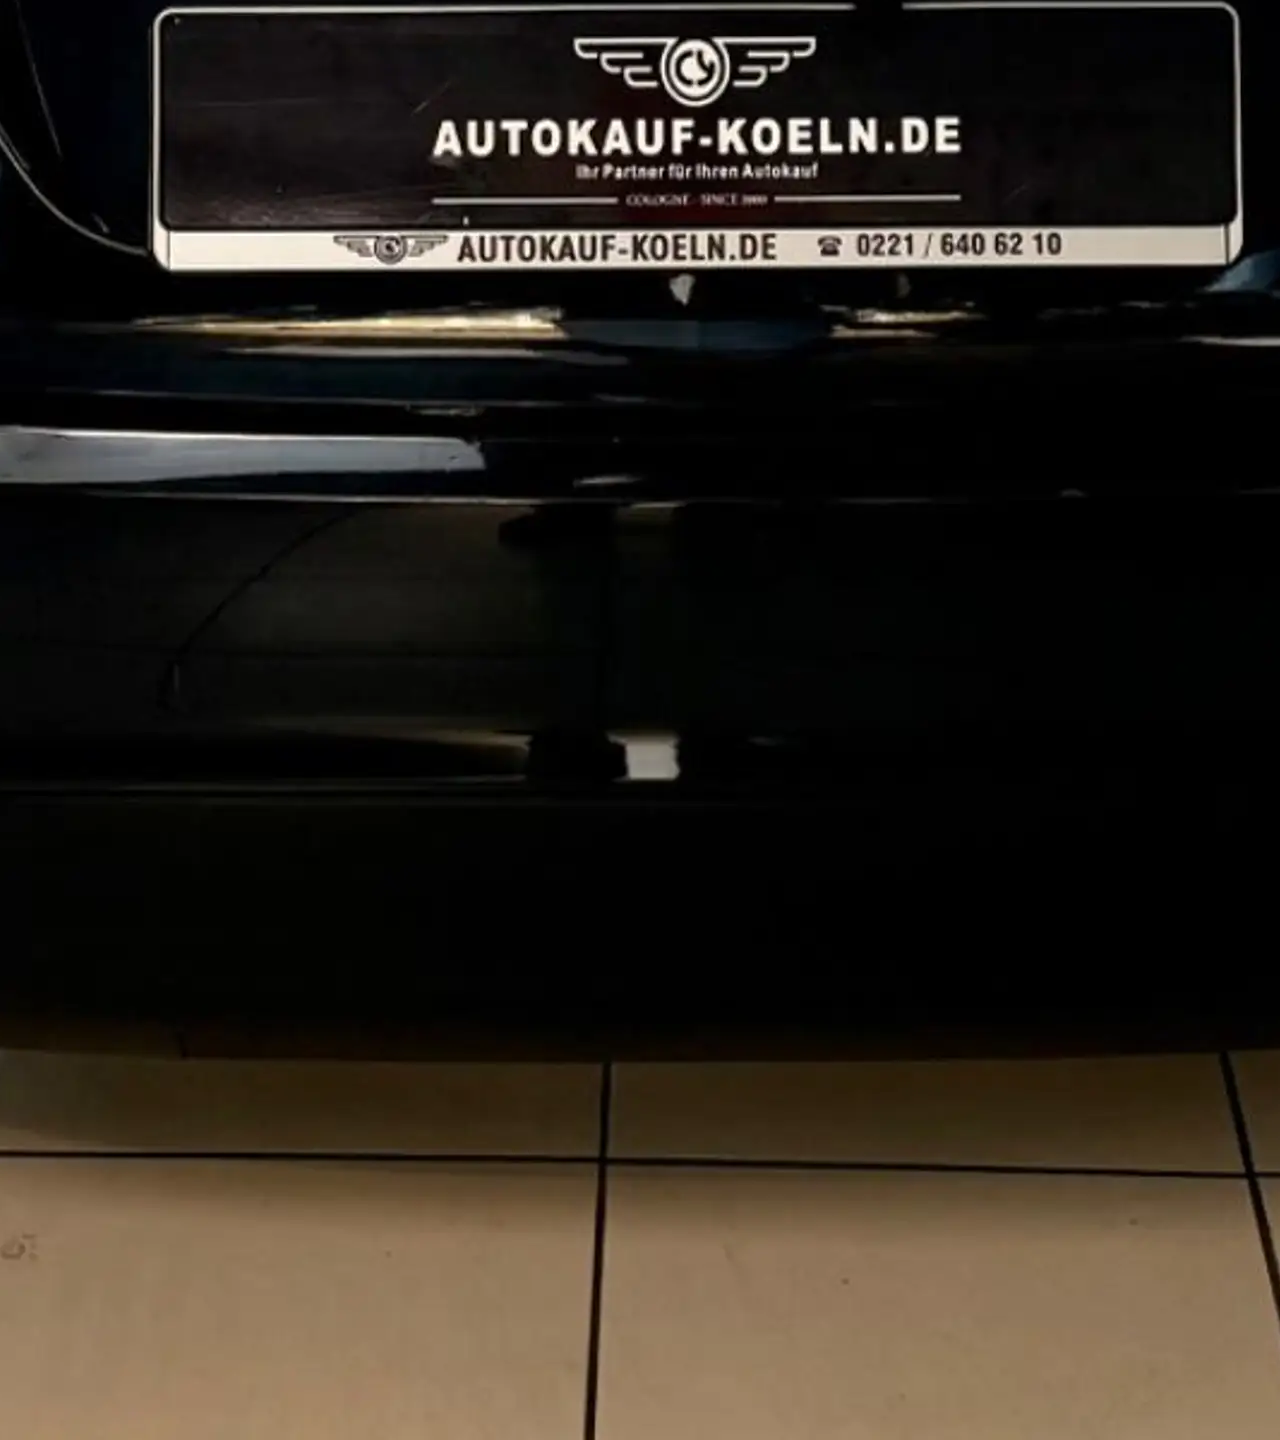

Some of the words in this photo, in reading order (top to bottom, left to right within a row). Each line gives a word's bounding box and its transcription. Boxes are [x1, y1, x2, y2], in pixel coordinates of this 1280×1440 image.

[432, 116, 961, 158] AUTOKAUF-KOELN.DE
[575, 163, 600, 179] Ihr
[602, 162, 665, 180] Partner
[668, 162, 693, 180] für
[695, 162, 739, 180] Ihren
[742, 161, 819, 181] Autokauf
[457, 234, 777, 262] AUTOKAUF-KOELN.DE
[857, 233, 914, 256] 0221
[940, 233, 986, 256] 640
[994, 233, 1023, 255] 62
[1032, 232, 1063, 255] 10
